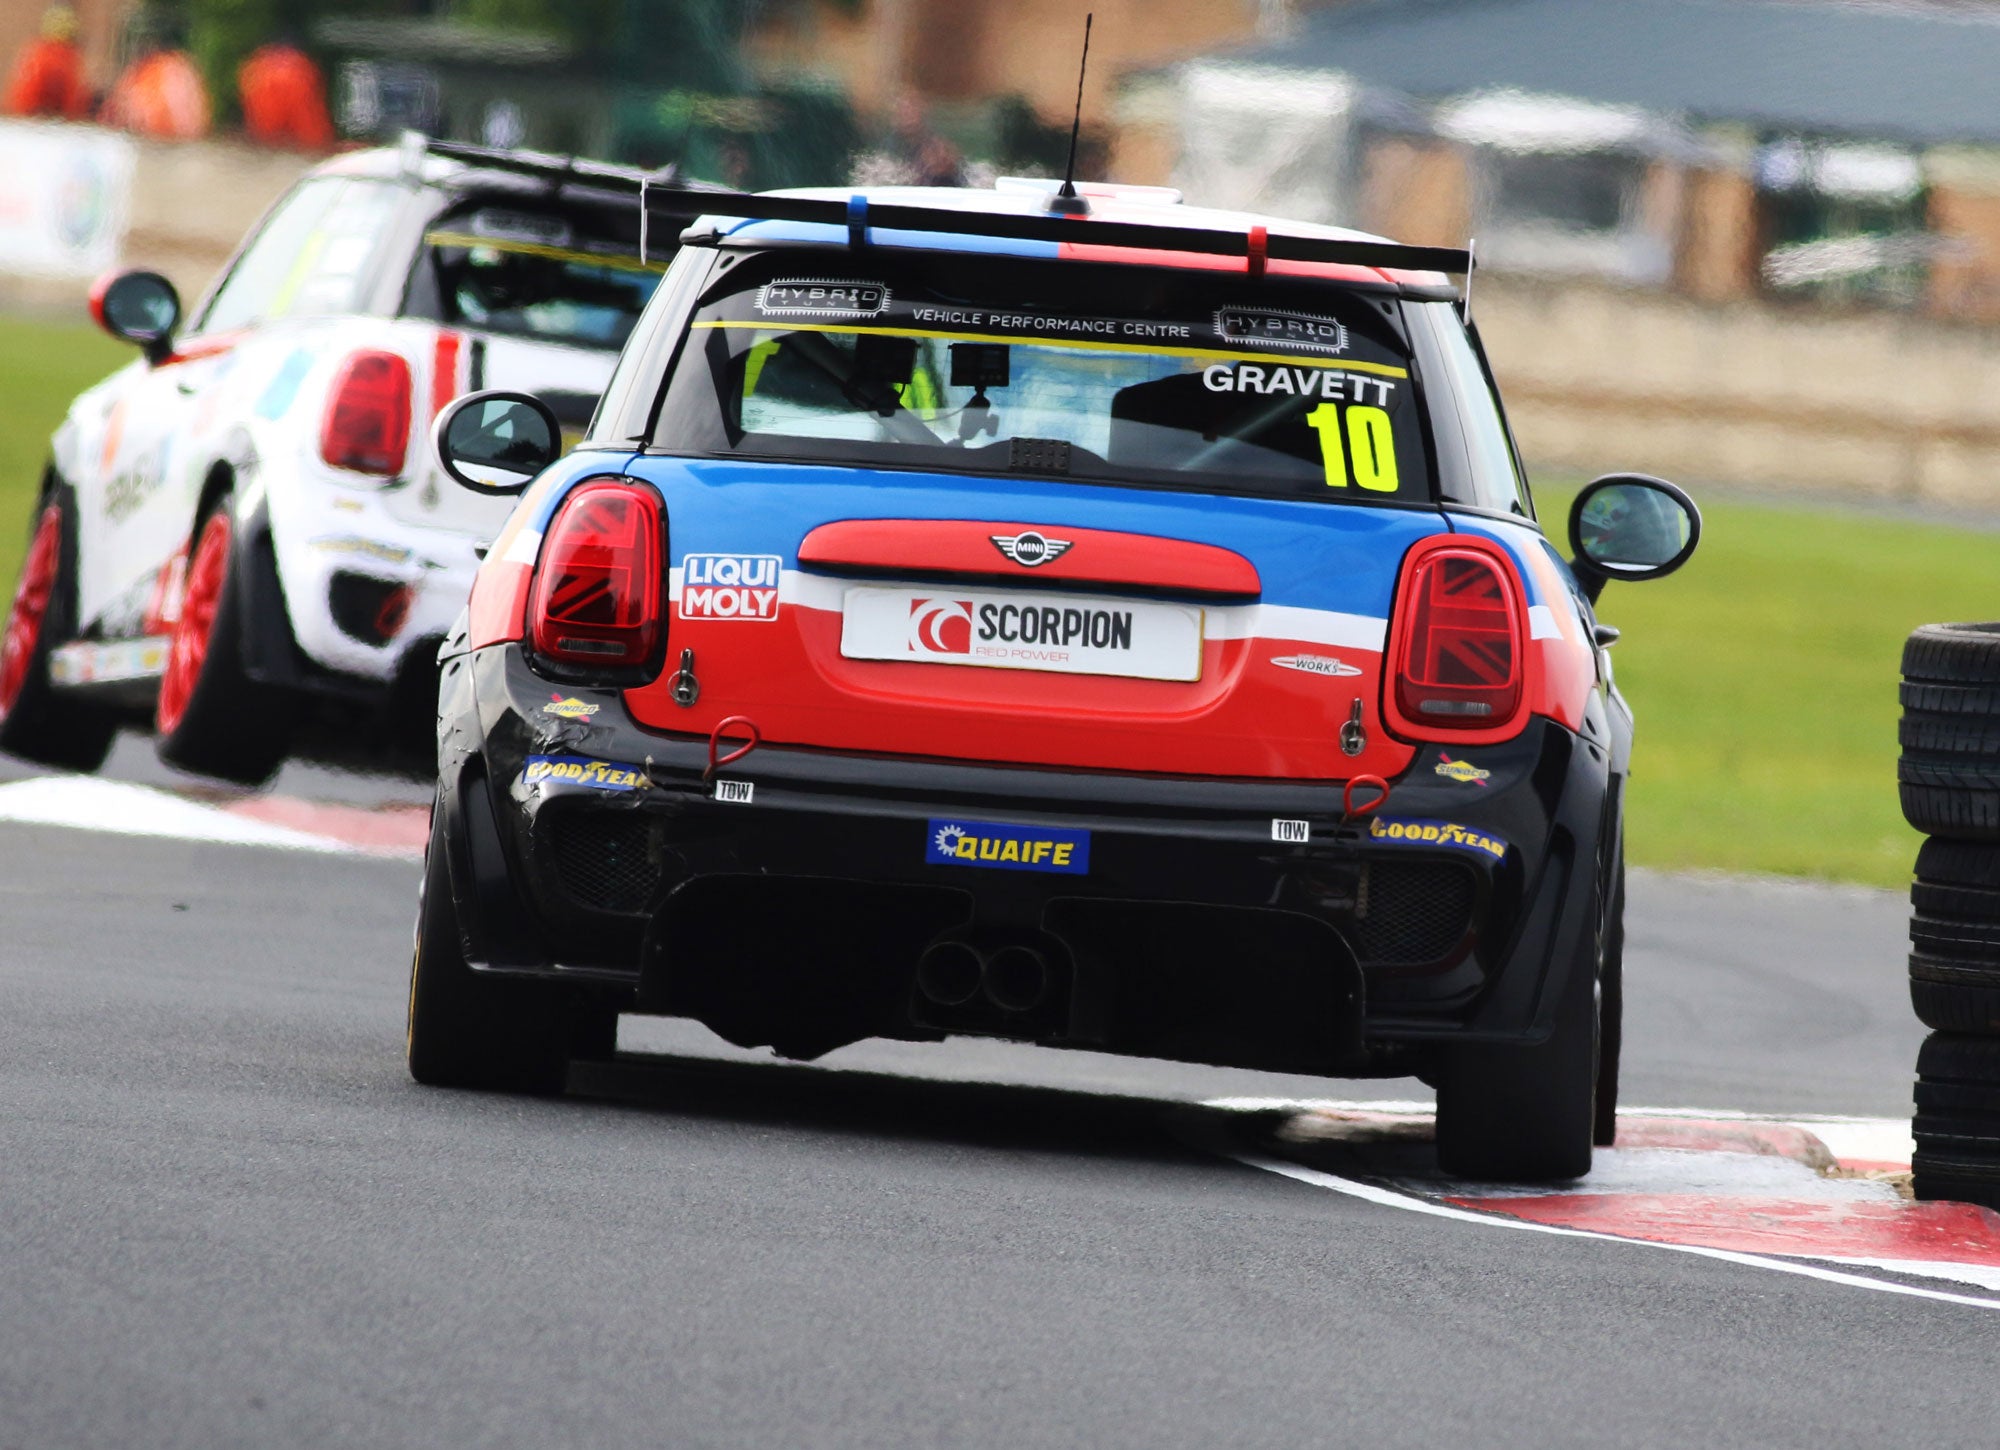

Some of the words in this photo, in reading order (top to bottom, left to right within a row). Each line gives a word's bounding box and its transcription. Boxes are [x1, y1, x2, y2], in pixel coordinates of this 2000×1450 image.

[769, 288, 878, 301] HYBRID
[912, 308, 982, 325] VEHICLE
[989, 315, 1116, 334] PERFORMANCE
[1123, 323, 1190, 338] CENTRE
[1225, 316, 1335, 337] HYBRID
[1202, 365, 1396, 406] GRAVETT
[1306, 402, 1399, 493] 10
[1017, 542, 1044, 554] MINI
[688, 556, 776, 586] LIQUI
[685, 588, 775, 618] MOLY
[977, 603, 1132, 650] SCORPION
[976, 646, 1008, 658] RED
[1010, 649, 1070, 662] POWER
[1296, 660, 1338, 674] WORKS
[546, 702, 598, 714] SUNOCO
[1437, 764, 1488, 779] SUNOCO
[719, 781, 750, 802] TOW
[1276, 821, 1307, 842] TOW
[955, 837, 1074, 865] QUAIFE
